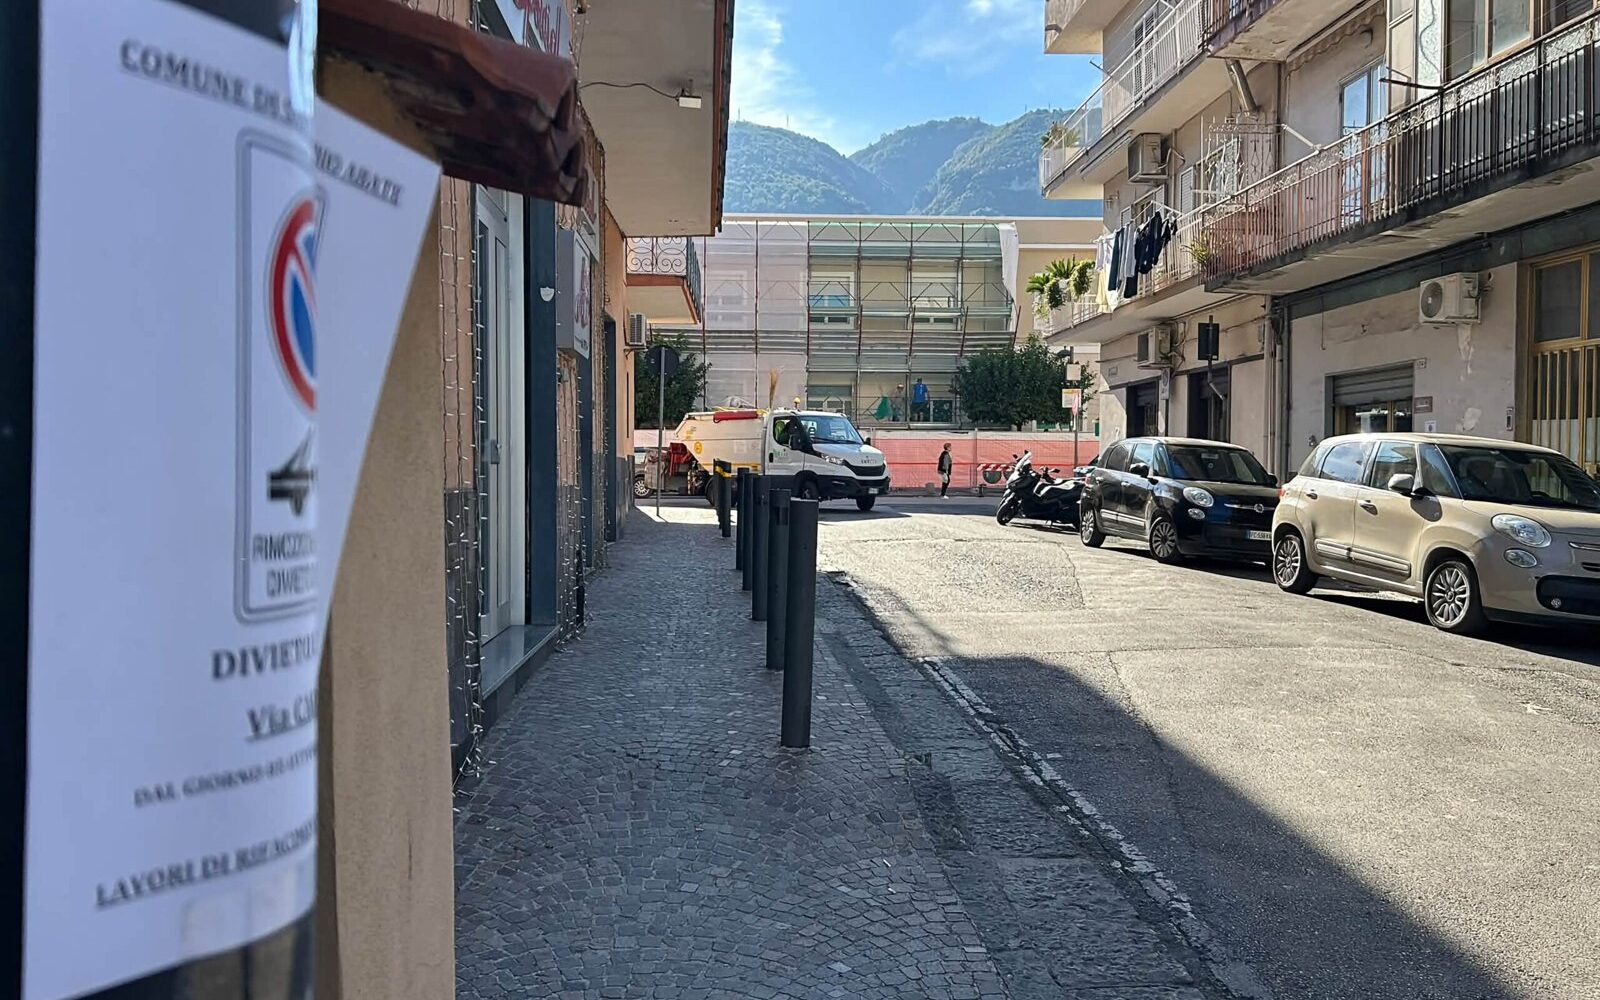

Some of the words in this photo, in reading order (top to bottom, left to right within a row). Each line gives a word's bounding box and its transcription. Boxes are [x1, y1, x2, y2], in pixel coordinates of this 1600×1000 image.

[120, 38, 248, 107] COMUNE
[245, 704, 290, 742] Via
[133, 781, 176, 808] DAL
[95, 857, 197, 908] LAVORI
[200, 852, 231, 881] DI
